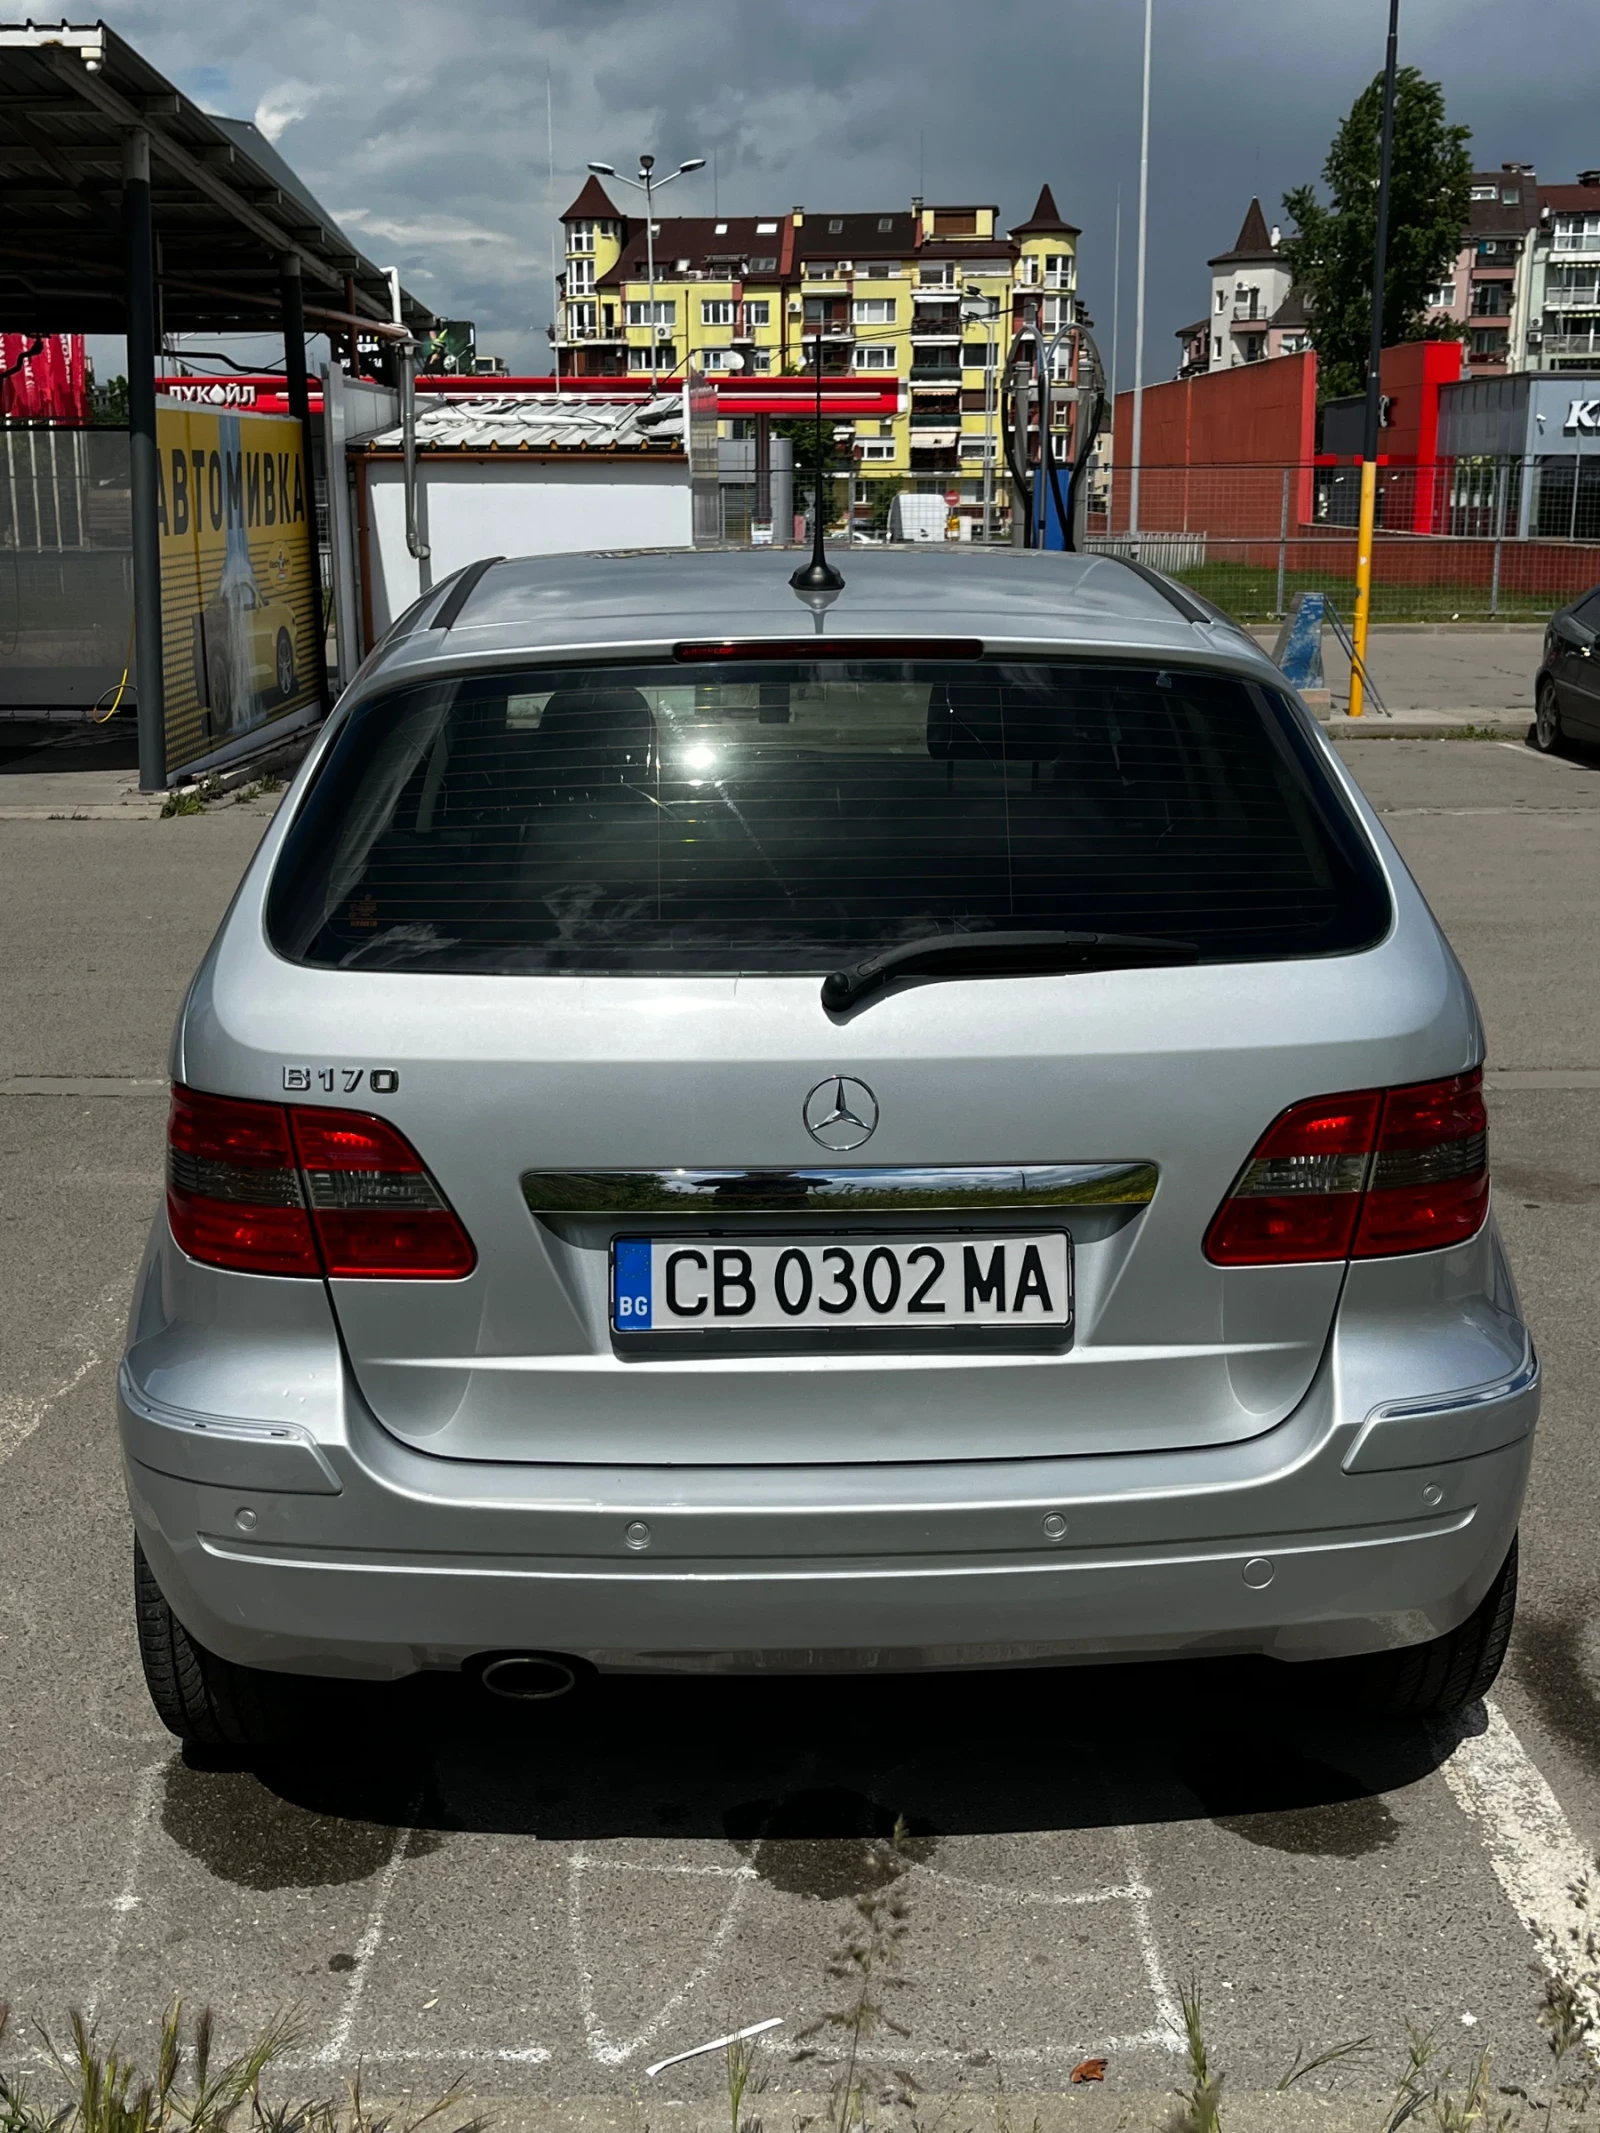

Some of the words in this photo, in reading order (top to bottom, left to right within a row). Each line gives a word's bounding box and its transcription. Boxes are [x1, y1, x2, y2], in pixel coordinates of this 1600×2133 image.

[282, 1066, 400, 1094] B170
[665, 1248, 756, 1317] CB
[774, 1246, 946, 1316] 0302
[964, 1244, 1053, 1313] MA
[618, 1296, 649, 1317] BG
